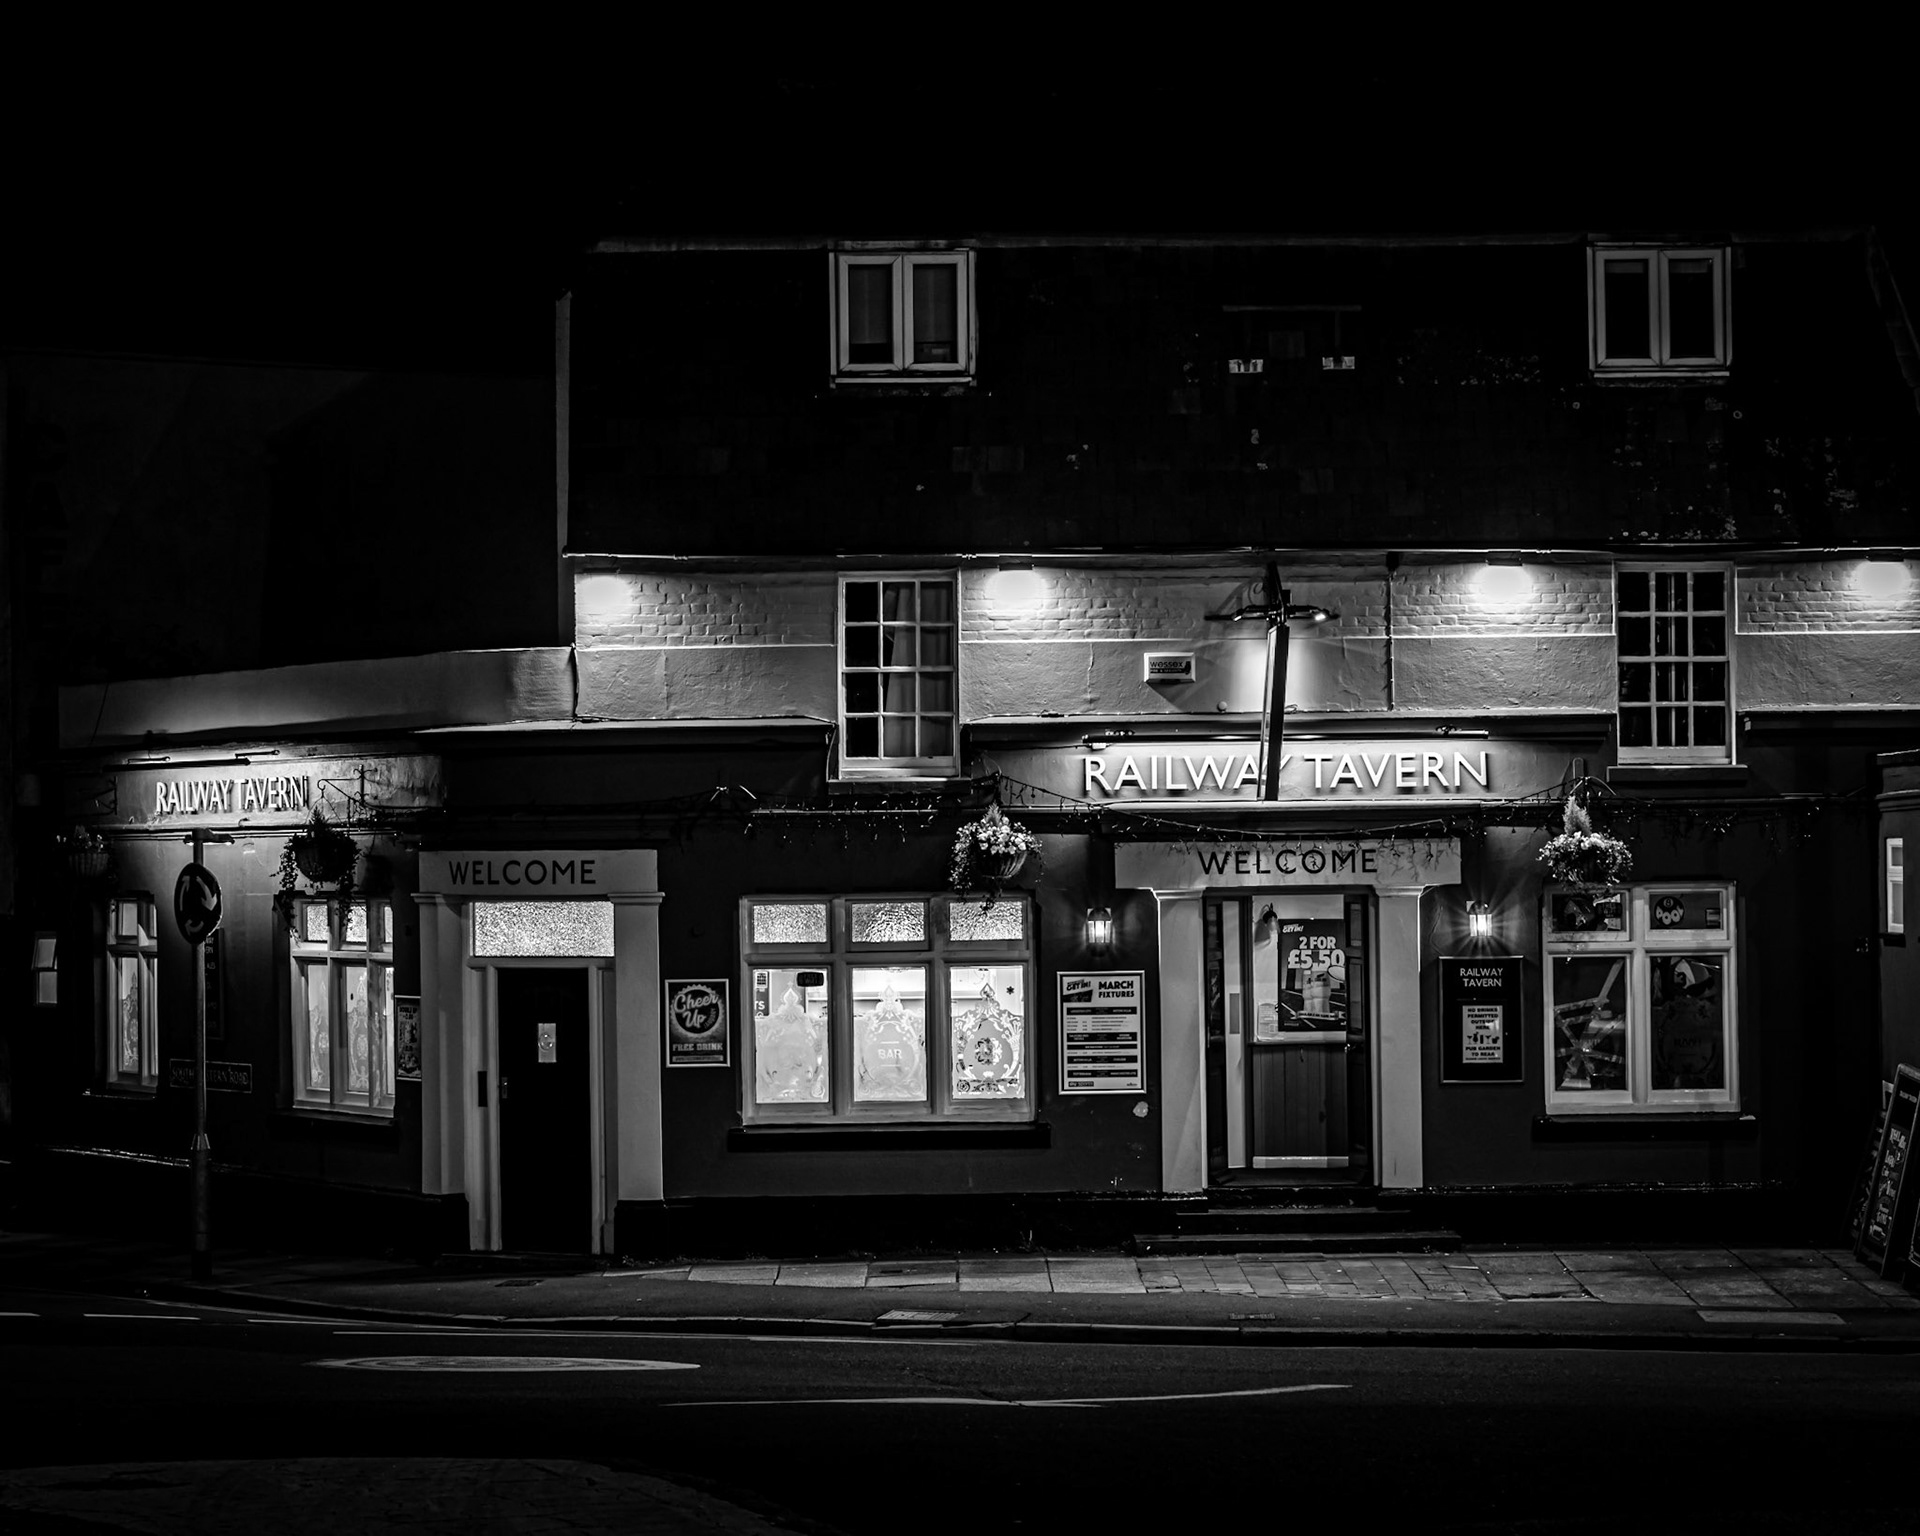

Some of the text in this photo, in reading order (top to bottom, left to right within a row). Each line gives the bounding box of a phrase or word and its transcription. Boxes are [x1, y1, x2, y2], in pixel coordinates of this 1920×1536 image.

[1303, 750, 1487, 790] TAVERN
[156, 776, 307, 813] RAILWAY TAVERN
[1197, 848, 1377, 875] WELCOME
[449, 860, 597, 885] WELCOME
[1299, 936, 1337, 949] 2 FOR
[1460, 968, 1504, 977] RAILWAY
[1098, 980, 1134, 990] MARCH
[1463, 978, 1502, 987] TAVERN
[1098, 990, 1135, 998] FIXTURES
[674, 993, 719, 1013] Cheer
[682, 1009, 707, 1029] Up
[672, 1042, 723, 1051] FREE DRINK
[877, 1048, 902, 1060] BAR
